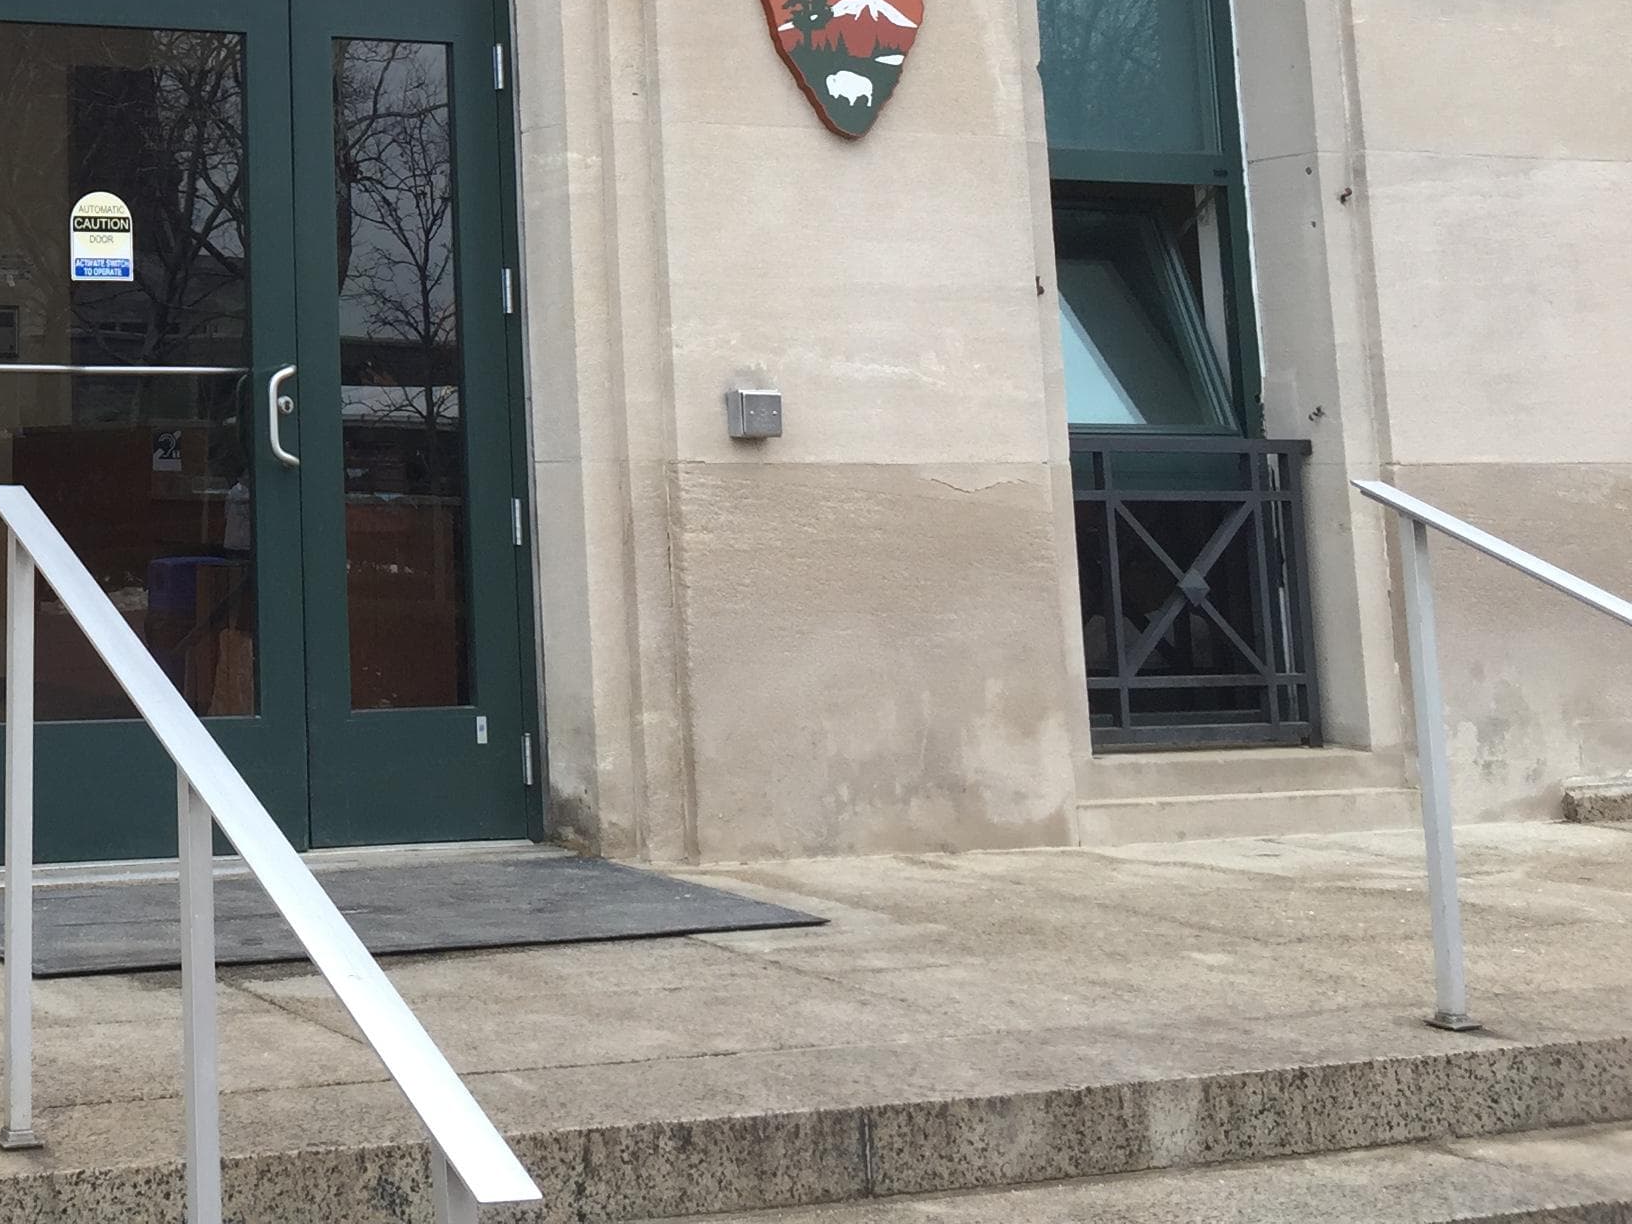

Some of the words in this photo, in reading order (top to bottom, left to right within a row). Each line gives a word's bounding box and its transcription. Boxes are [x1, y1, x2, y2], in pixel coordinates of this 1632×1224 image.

[78, 205, 125, 214] AUTOMATIC
[74, 218, 129, 230] CAUTION
[89, 235, 114, 244] DOOR
[83, 267, 92, 275] TO
[93, 267, 122, 276] OPERATE
